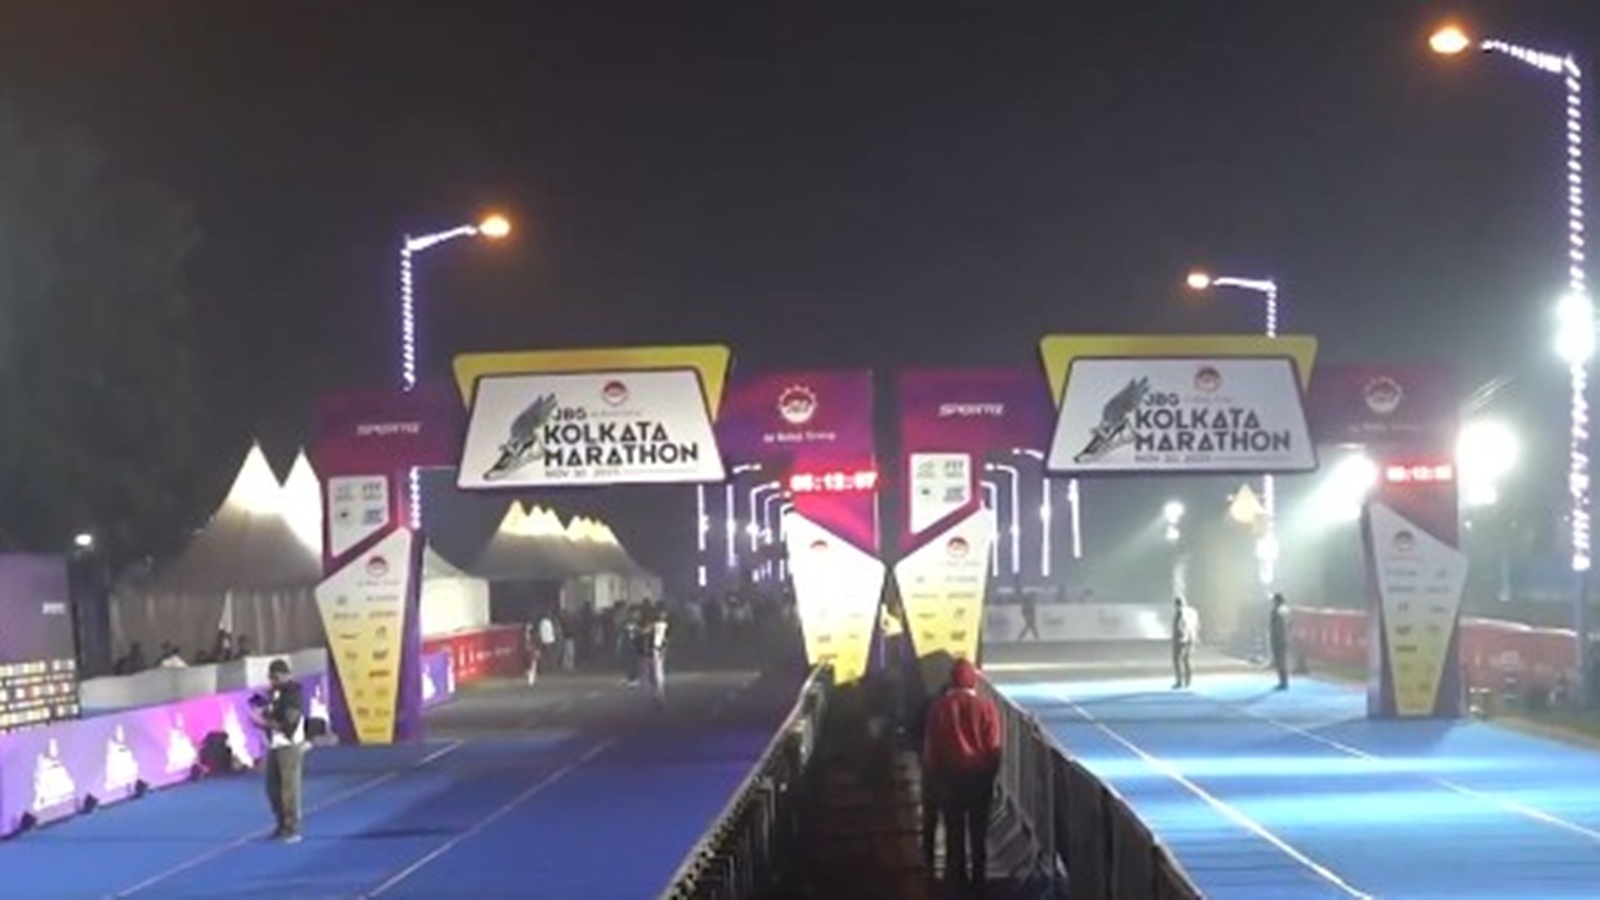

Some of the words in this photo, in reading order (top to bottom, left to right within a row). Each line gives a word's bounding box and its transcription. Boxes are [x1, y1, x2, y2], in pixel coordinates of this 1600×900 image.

[1135, 408, 1260, 430] KOLKATA
[544, 421, 668, 444] KOLKATA
[1135, 430, 1291, 451] MARATHON
[544, 443, 698, 467] MARATHON
